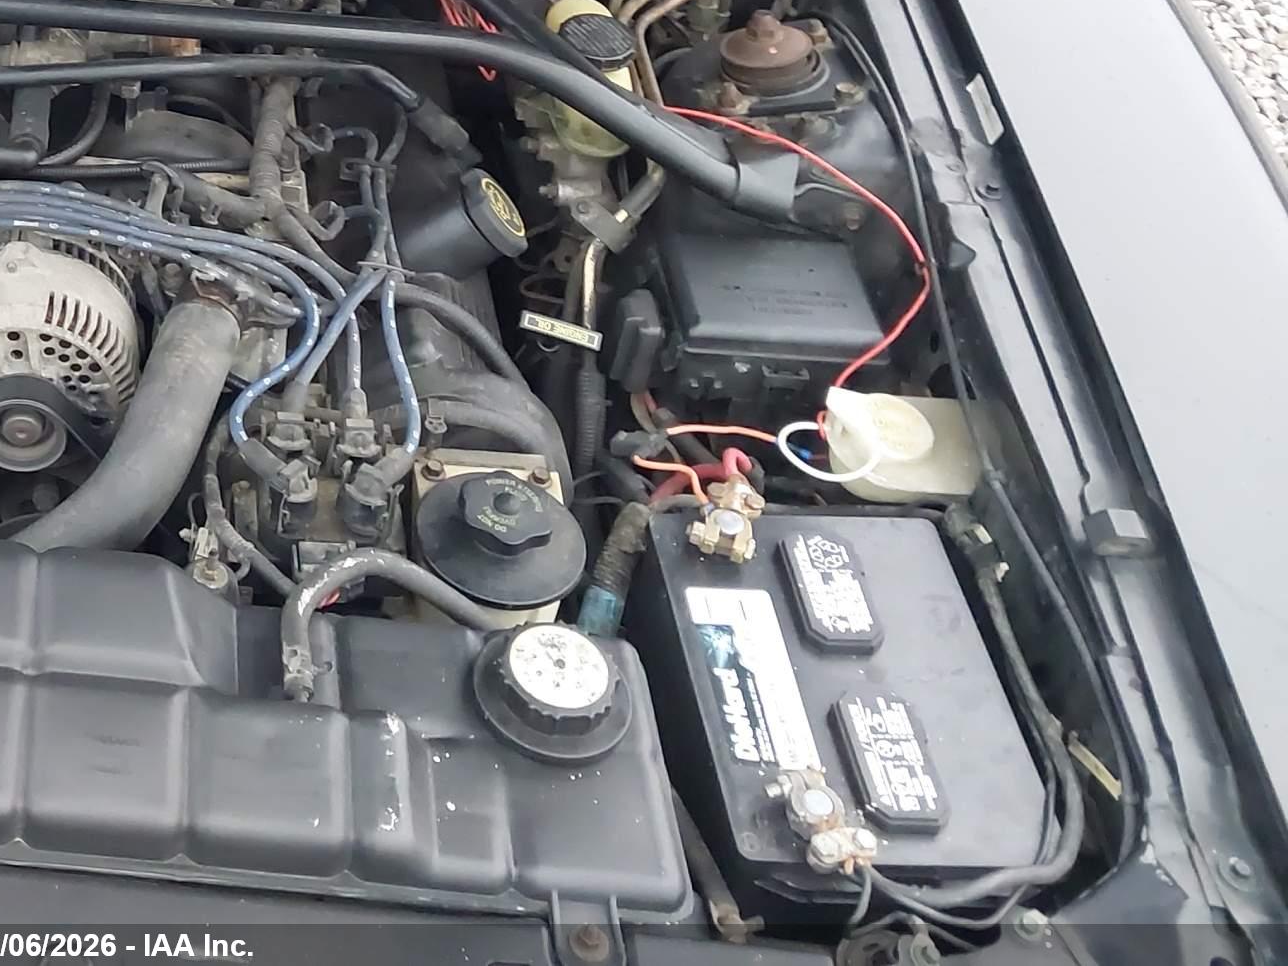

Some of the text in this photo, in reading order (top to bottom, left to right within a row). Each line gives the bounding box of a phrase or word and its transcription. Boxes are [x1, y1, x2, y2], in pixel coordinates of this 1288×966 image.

[536, 318, 589, 341] ENGINE OIL
[476, 514, 508, 533] DO NOT
